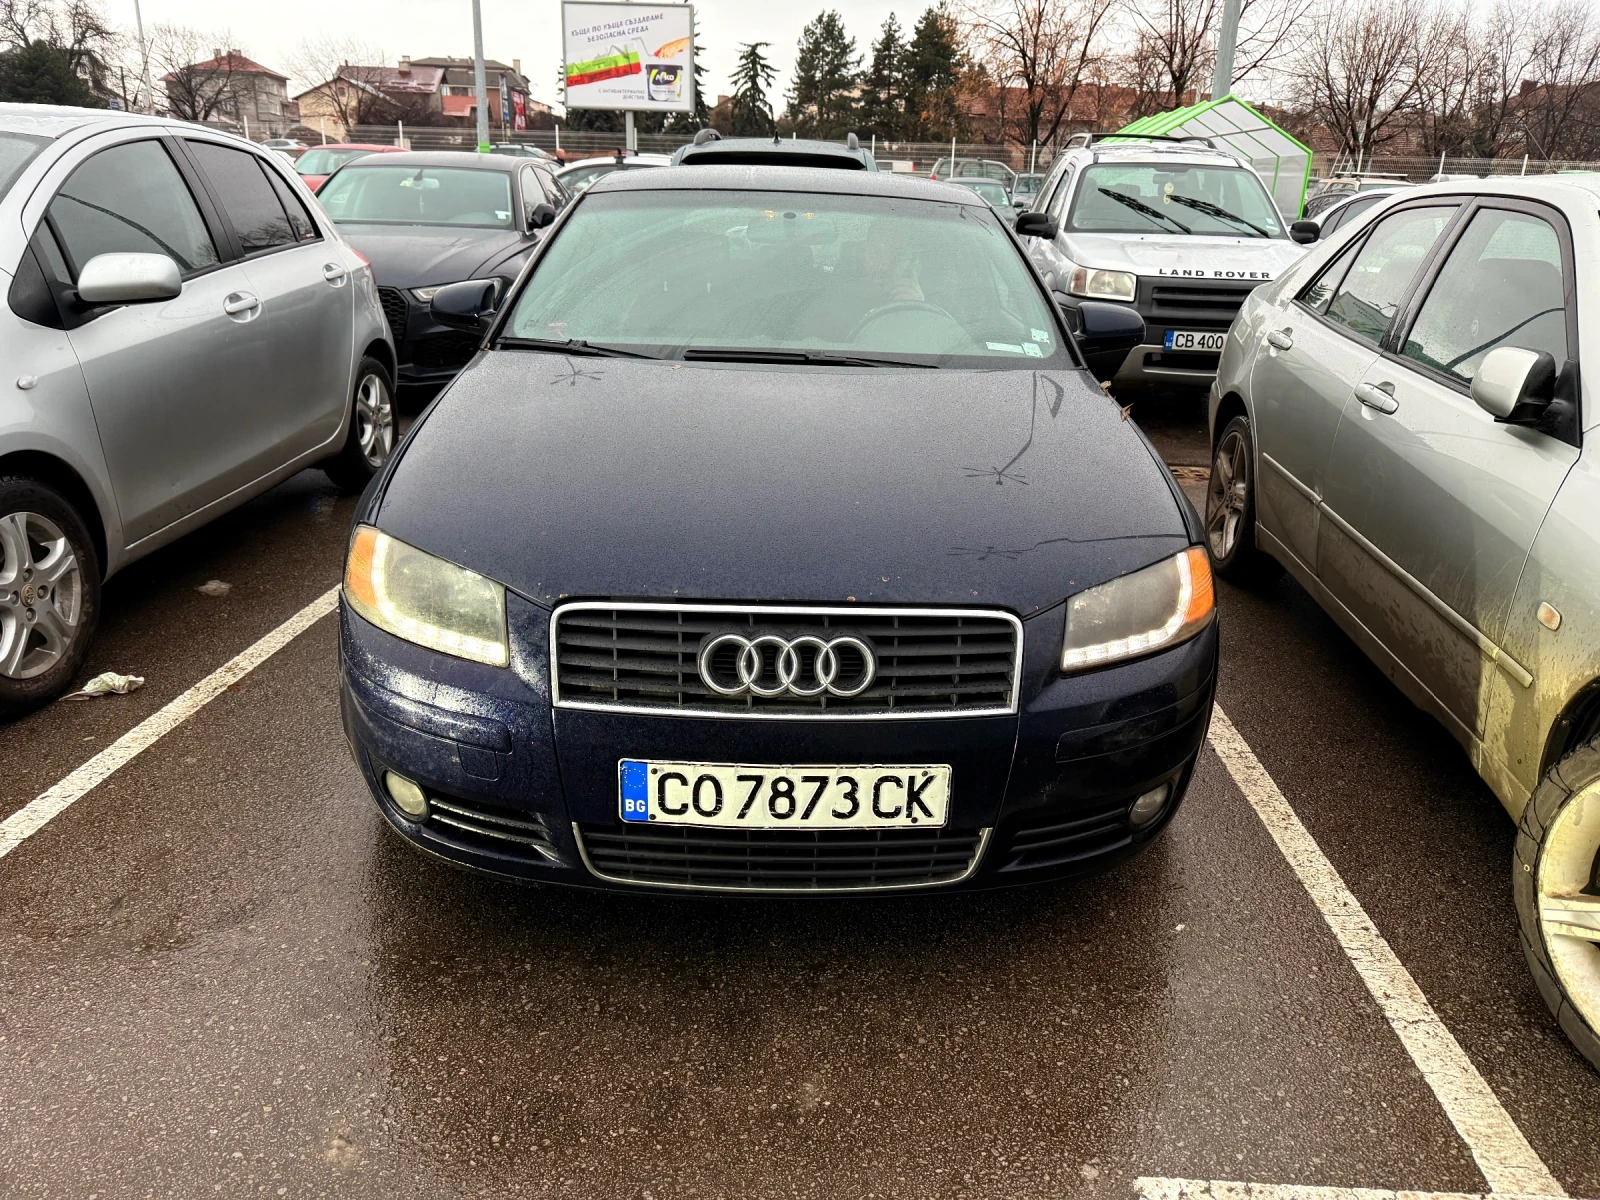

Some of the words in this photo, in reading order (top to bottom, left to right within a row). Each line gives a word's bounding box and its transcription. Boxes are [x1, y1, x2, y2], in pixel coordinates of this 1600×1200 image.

[571, 27, 591, 37] КЪЩА
[592, 25, 602, 33] ПО
[603, 20, 624, 31] КЪЩА
[624, 13, 664, 27] СЪЗДАВАМЕ
[587, 30, 626, 43] БЕЗОПАСНА
[628, 25, 649, 35] СРЕДА
[1159, 268, 1205, 277] LAND
[1214, 271, 1270, 279] ROVER
[1175, 333, 1195, 348] CB
[1197, 334, 1224, 349] 400
[657, 772, 724, 818] CO
[736, 774, 861, 821] 7873
[871, 774, 937, 820] CK
[625, 799, 646, 813] BG
